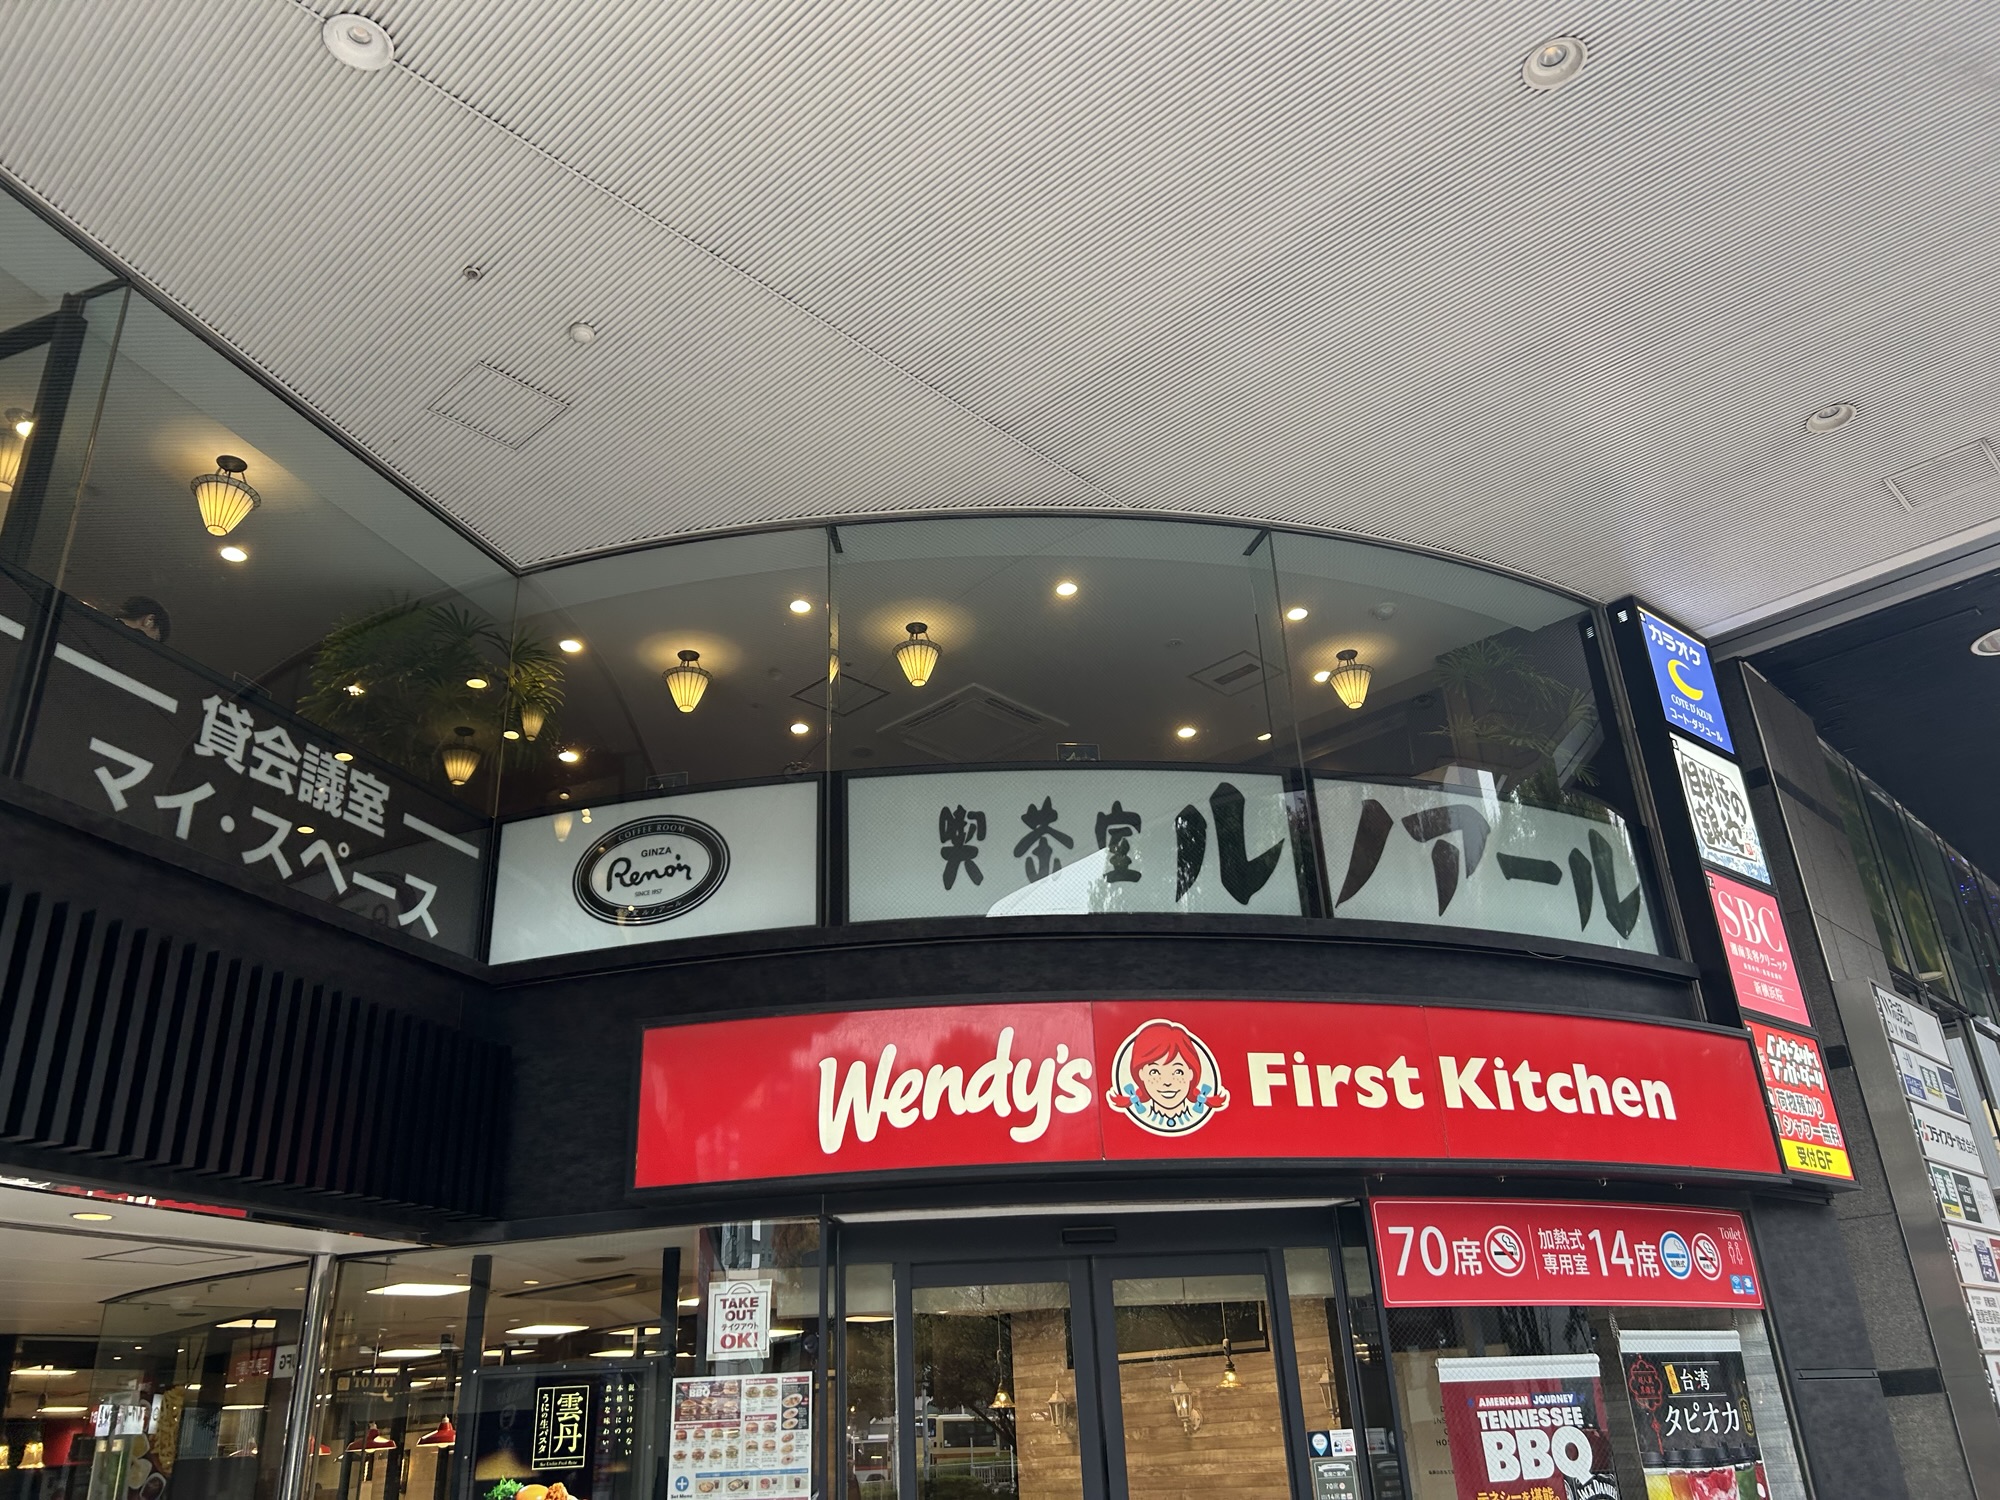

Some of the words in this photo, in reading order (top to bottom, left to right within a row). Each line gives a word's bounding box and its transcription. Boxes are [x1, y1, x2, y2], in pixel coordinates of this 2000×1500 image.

[1648, 623, 1701, 666] カラオケ
[194, 694, 392, 838] 貸会議室
[90, 737, 439, 938] マイ・スペース
[618, 824, 652, 841] COFFEE
[656, 823, 685, 833] ROOM
[640, 846, 673, 858] GINZA
[606, 854, 692, 893] Renoir
[634, 890, 650, 898] SINCE
[1717, 891, 1783, 953] SBC
[817, 1026, 1092, 1155] Wendy's
[1246, 1051, 1425, 1110] First
[1438, 1055, 1678, 1122] Kitchen
[1775, 1088, 1825, 1119] 荷物預かり
[1796, 1145, 1833, 1170] 受付6F
[1537, 1227, 1586, 1251] 加熱式
[1717, 1226, 1743, 1242] Toilet
[1387, 1225, 1484, 1277] 70席
[1542, 1252, 1590, 1277] 専用室
[720, 1296, 759, 1309] TAKE
[721, 1322, 759, 1332] テイクアウト
[725, 1309, 756, 1322] OUT
[720, 1331, 759, 1349] OK!
[353, 1376, 370, 1388] TO
[374, 1376, 396, 1388] LET
[1680, 1367, 1710, 1391] 台湾
[1478, 1395, 1529, 1407] AMERICAN
[1532, 1393, 1574, 1405] JOURNEY
[538, 1393, 550, 1454] うにの生パスタ
[553, 1392, 584, 1454] 雲丹
[1476, 1406, 1585, 1430] TENNESSEE
[1665, 1401, 1740, 1437] タピオカ
[1480, 1425, 1593, 1485] BBQ
